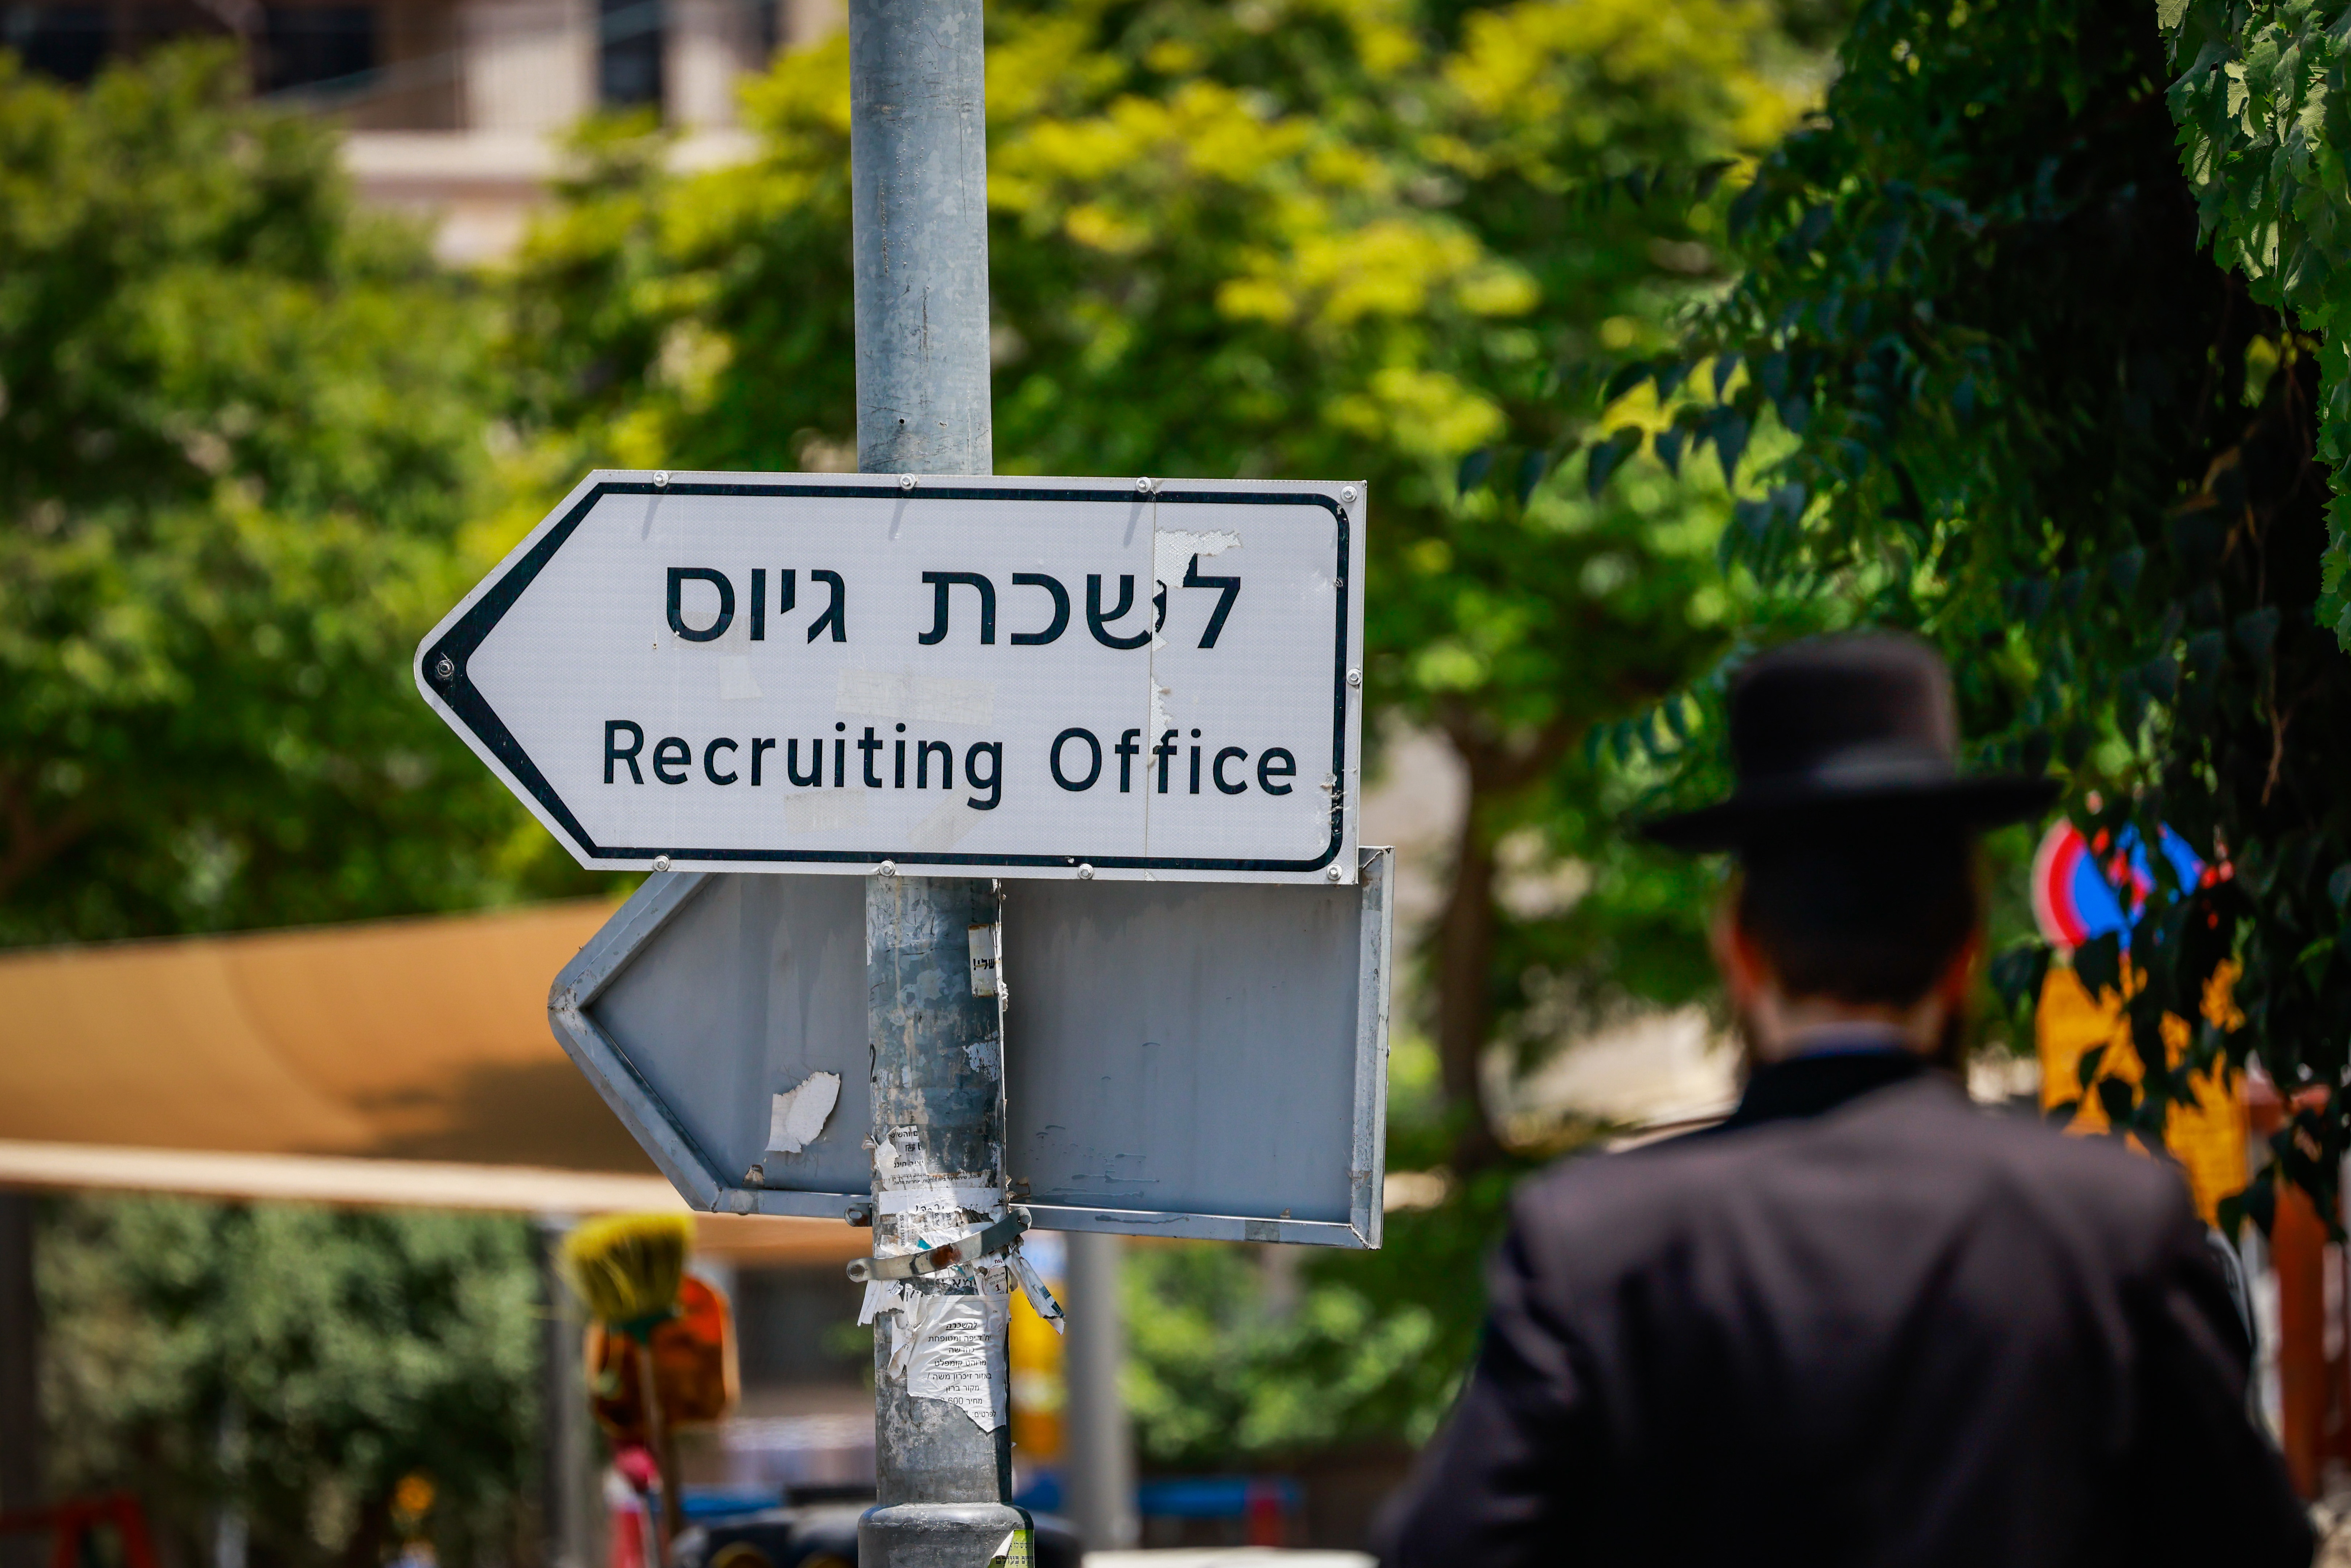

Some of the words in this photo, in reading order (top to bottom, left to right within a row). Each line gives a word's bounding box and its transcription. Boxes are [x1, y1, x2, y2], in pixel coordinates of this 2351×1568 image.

[666, 566, 847, 645] גיוס
[918, 552, 1241, 650] לשכת
[603, 719, 1003, 811] Recruiting
[1050, 727, 1297, 796] Office
[946, 1321, 978, 1330] להשכרה
[934, 1359, 963, 1368] קומפלט
[962, 1385, 980, 1393] מקור
[972, 1409, 996, 1418] לפרטים:
